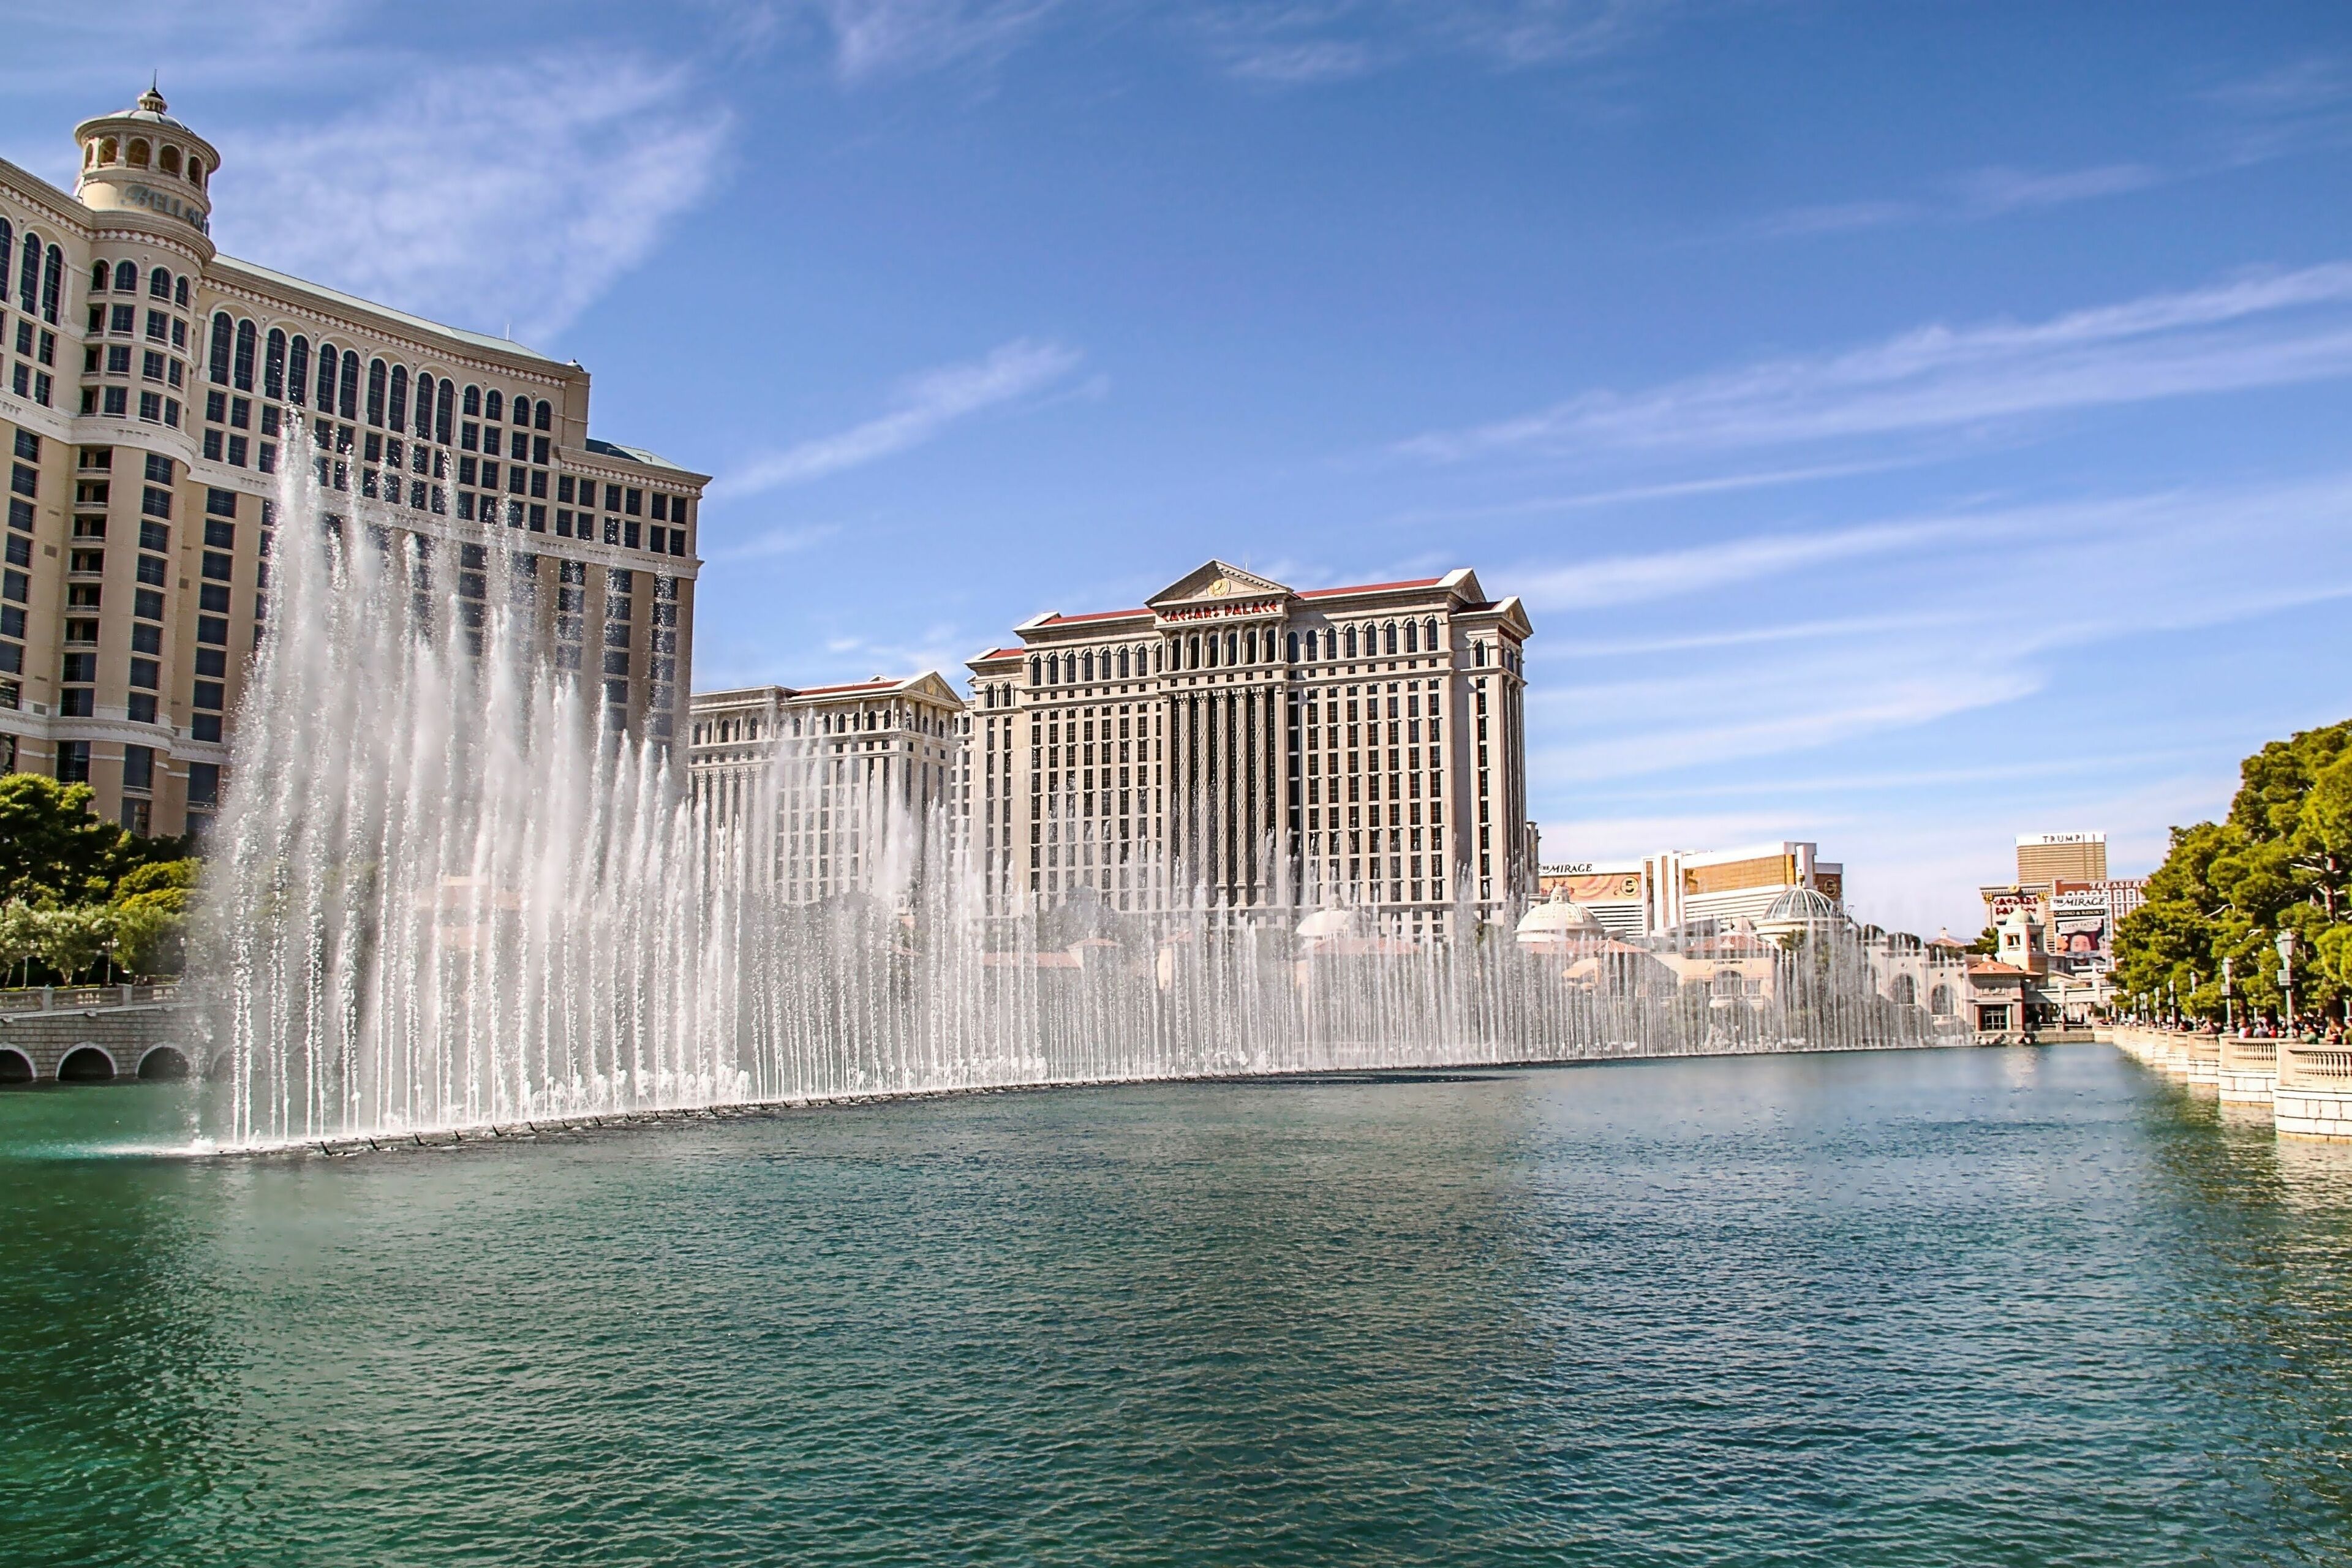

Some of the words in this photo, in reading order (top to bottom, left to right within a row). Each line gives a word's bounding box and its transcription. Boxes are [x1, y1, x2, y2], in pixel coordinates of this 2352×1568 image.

[121, 184, 209, 237] BELLAG
[1161, 605, 1219, 622] CAESARS
[1225, 600, 1277, 617] PALACE
[2043, 834, 2080, 843] TRUMP
[1544, 864, 1593, 873] MIRAGE
[2057, 898, 2105, 907] MIRAGE
